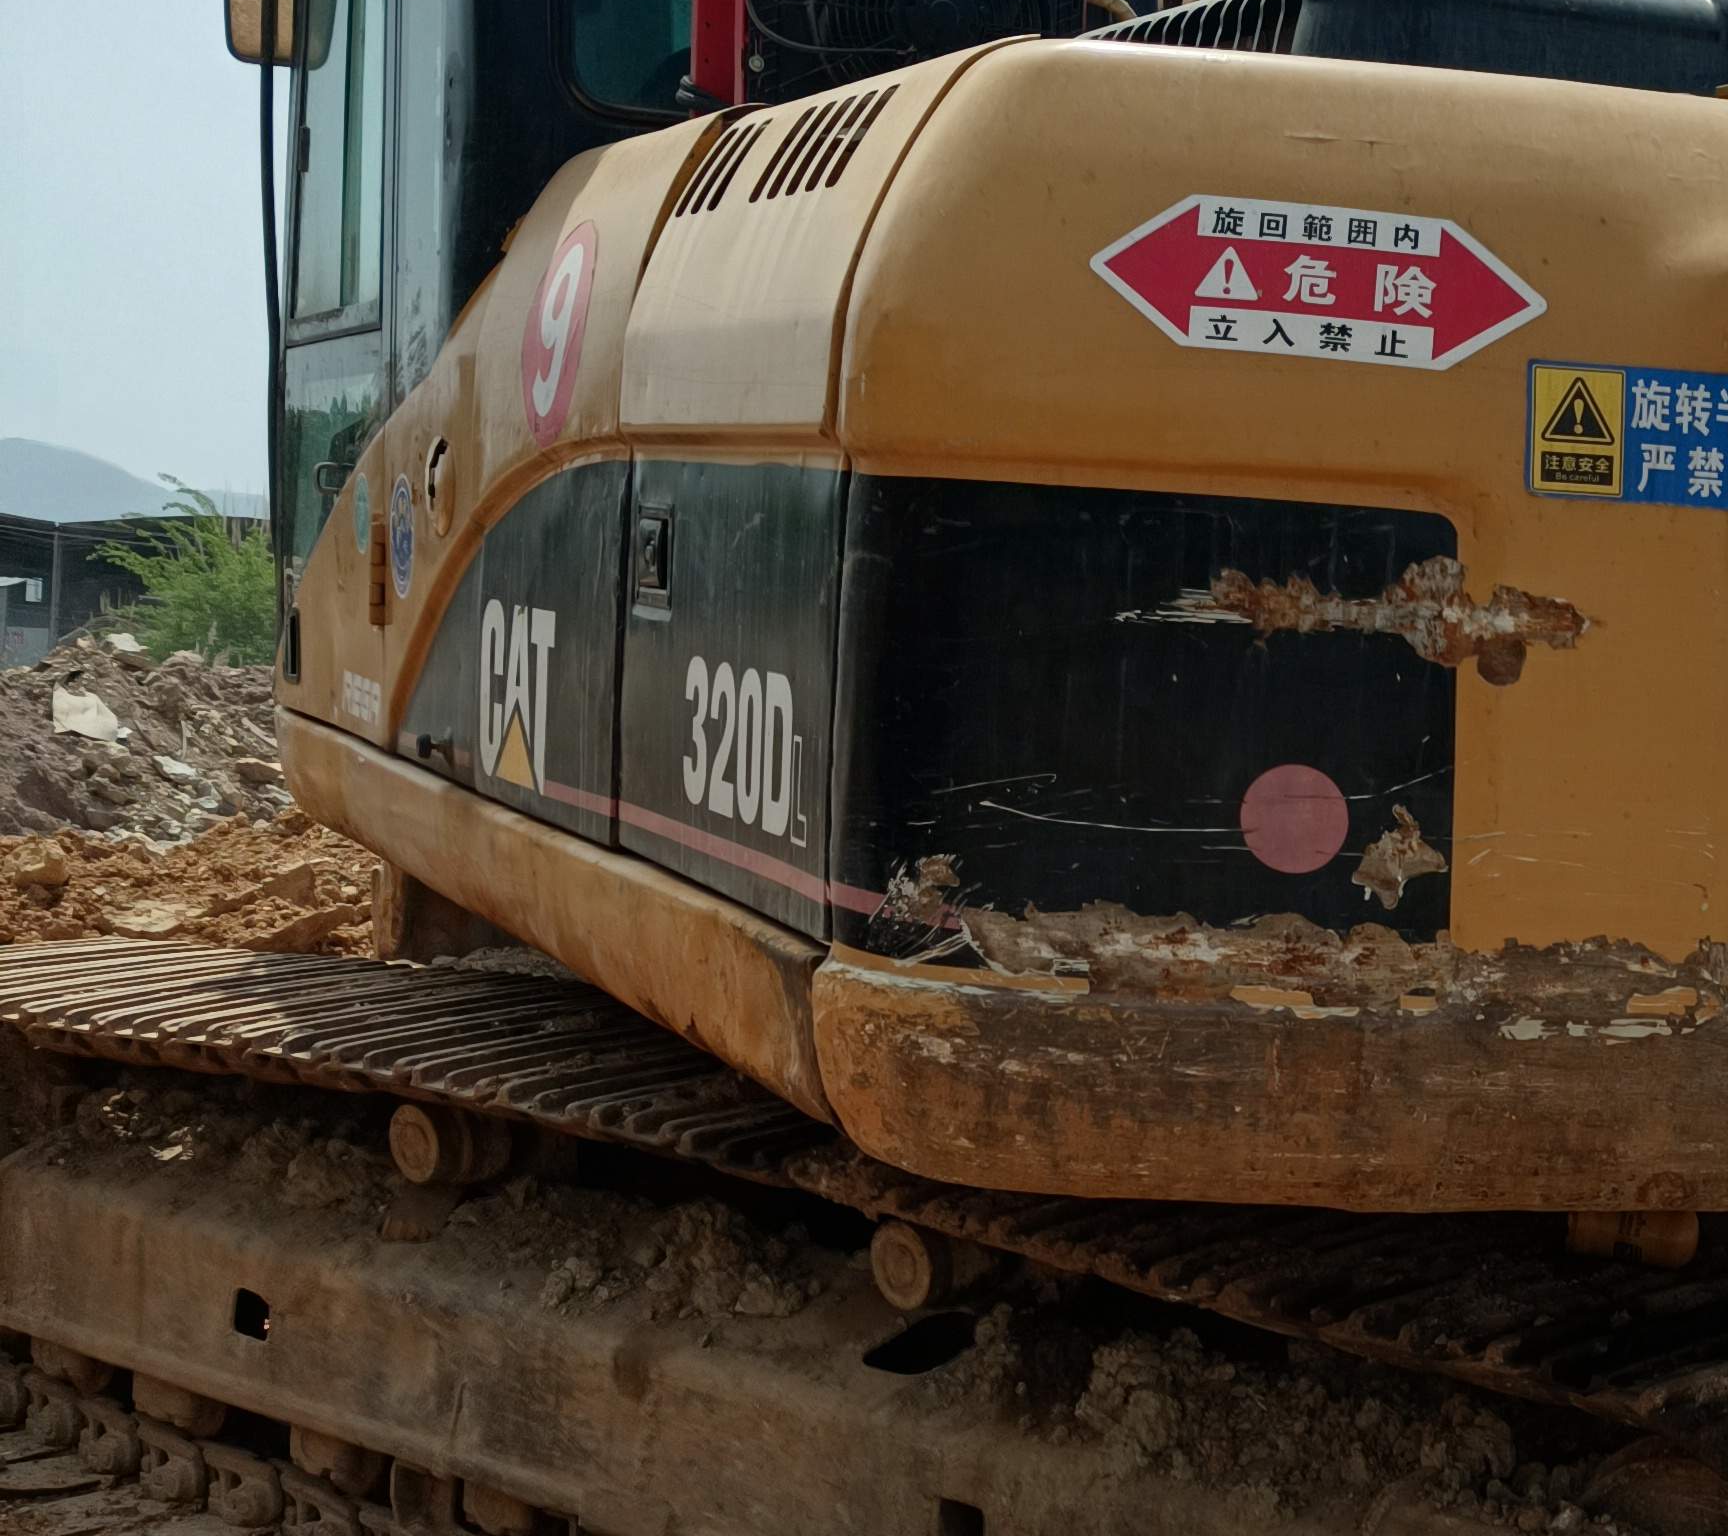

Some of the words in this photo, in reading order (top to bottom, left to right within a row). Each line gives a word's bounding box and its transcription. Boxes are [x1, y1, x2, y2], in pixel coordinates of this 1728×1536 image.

[1211, 206, 1420, 250] 旋回範囲内
[1282, 254, 1437, 318] 危険
[532, 243, 584, 417] 9
[1205, 314, 1409, 359] 立入禁止
[1544, 454, 1610, 474] 注意安全
[1555, 471, 1568, 482] Be
[1568, 472, 1600, 483] careful
[479, 598, 556, 796] CAT
